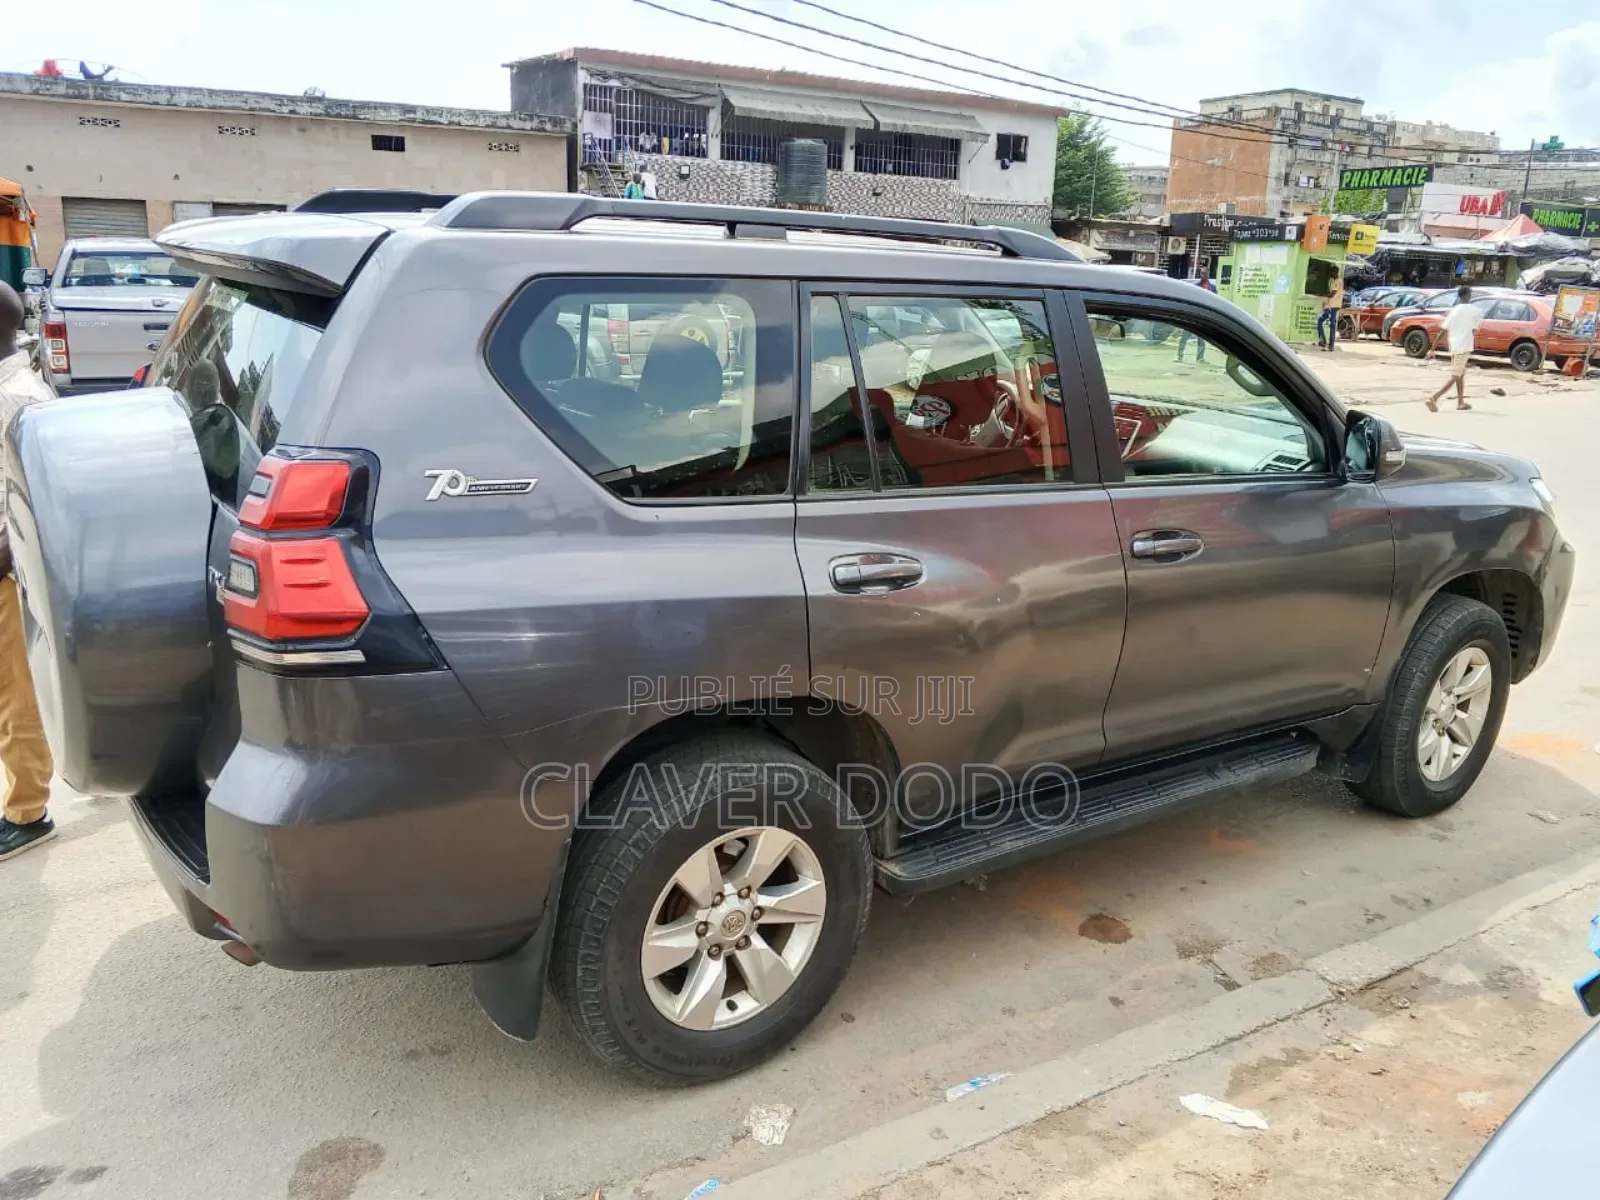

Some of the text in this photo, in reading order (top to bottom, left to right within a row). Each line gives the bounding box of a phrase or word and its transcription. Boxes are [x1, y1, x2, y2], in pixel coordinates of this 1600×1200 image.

[1342, 167, 1428, 188] PHARMACIE
[1459, 195, 1487, 214] UBA
[1532, 209, 1583, 229] PHARMACIE
